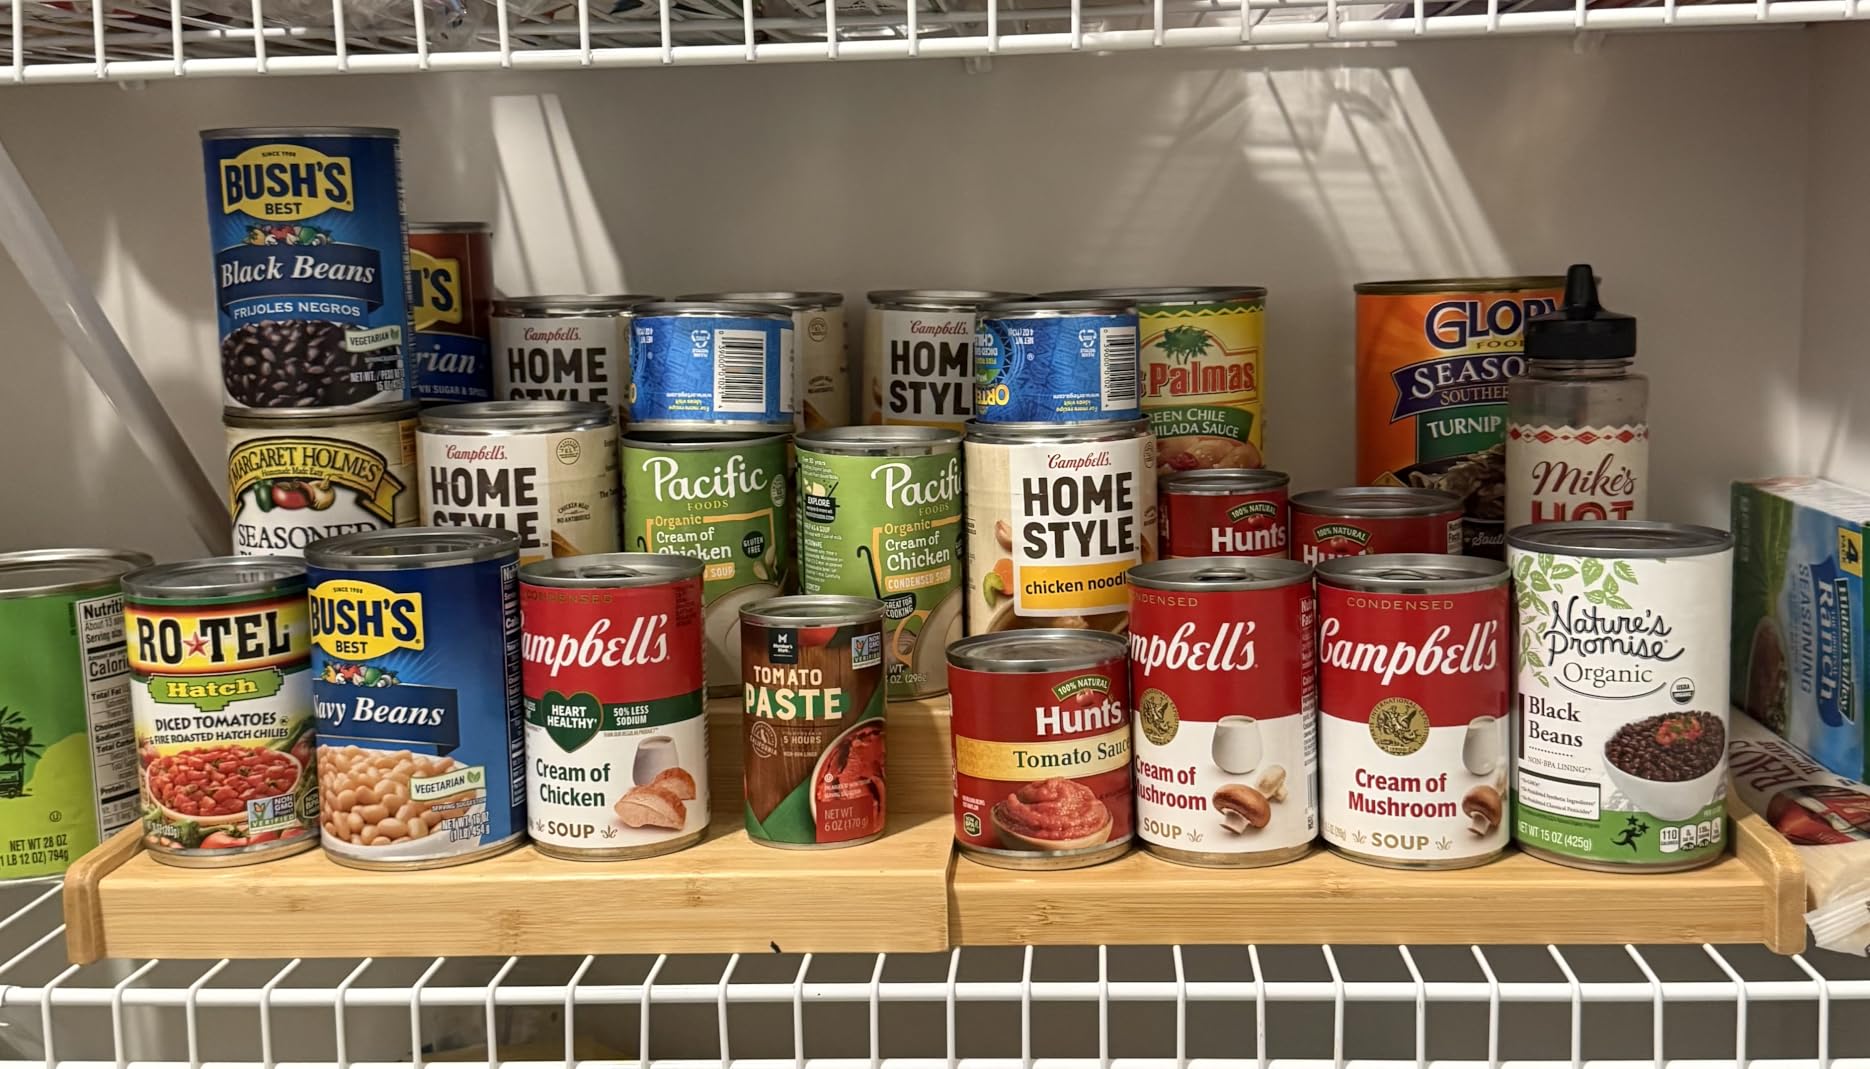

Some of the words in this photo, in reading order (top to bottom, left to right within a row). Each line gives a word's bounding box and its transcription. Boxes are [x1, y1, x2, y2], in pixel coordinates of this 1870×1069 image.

[224, 162, 350, 206] BUSH'S
[265, 203, 302, 215] BEST
[222, 257, 284, 288] Black
[292, 256, 375, 283] Beans
[234, 302, 293, 320] FRIJOLES
[298, 302, 360, 316] NEGROS
[350, 331, 389, 345] VEGETARIAN
[523, 327, 580, 345] Campbell's
[910, 321, 968, 336] Campbell's
[508, 353, 608, 384] HOME
[891, 340, 976, 378] HOM
[1148, 360, 1256, 397] Palmas
[432, 387, 460, 396] SUGAR
[890, 380, 976, 416] STYL
[1187, 408, 1226, 422] CHILE
[1202, 422, 1239, 438] SAUCE
[1426, 416, 1502, 439] TURNIP
[231, 446, 297, 482] MARGARET
[302, 446, 380, 482] HOLMES
[446, 444, 508, 465] Campbell's
[1048, 451, 1112, 472] Campbell's
[642, 455, 768, 501] Pacific
[871, 457, 962, 509] Pacifi
[1532, 453, 1640, 497] Mike's
[430, 467, 538, 508] HOME
[1022, 472, 1133, 517] HOME
[687, 500, 729, 511] FOODS
[920, 503, 950, 517] FOODS
[1231, 506, 1248, 519] 100%
[1249, 503, 1276, 515] NATURAL
[655, 515, 702, 530] Organic
[885, 519, 930, 538] Organic
[657, 531, 697, 544] Cream
[700, 527, 715, 541] of
[743, 537, 763, 547] GLUTEN
[885, 536, 927, 552] Cream
[928, 531, 940, 547] of
[1023, 516, 1136, 559] STYLE
[1316, 528, 1332, 538] 100%
[1332, 526, 1366, 541] NATURAL
[1840, 535, 1848, 563] PACK
[1846, 538, 1860, 565] 4
[887, 548, 950, 571] Chicken
[711, 567, 735, 578] SOUP
[888, 573, 934, 590] CONDENSED
[1025, 580, 1083, 595] chicken
[1088, 571, 1128, 592] noodl
[886, 600, 903, 609] GREAT
[1135, 593, 1198, 607] DENSED
[1346, 597, 1455, 610] CONDENSED
[311, 599, 418, 643] BUSH'S
[886, 605, 913, 618] COOKING
[1550, 596, 1672, 636] Nature's
[1837, 586, 1851, 653] Hidden
[1799, 564, 1812, 694] SEASONING
[335, 640, 368, 655] BEST
[1129, 621, 1256, 677] mpbell's
[1543, 630, 1685, 666] Promise
[1817, 580, 1838, 699] Ranch
[1320, 617, 1497, 685] Campbell's
[753, 665, 823, 686] TOMATO
[889, 664, 905, 673] WT.
[1563, 662, 1653, 687] Organic
[167, 679, 258, 699] Hatch
[1057, 682, 1076, 696] 100%
[1077, 678, 1109, 690] NATURAL
[1839, 657, 1853, 710] Valley
[91, 690, 109, 700] Total
[745, 682, 842, 721] PASTE
[352, 696, 444, 727] Beans
[550, 705, 587, 718] HEART
[613, 707, 630, 717] 50%
[631, 705, 649, 715] LESS
[1528, 696, 1582, 723] Black
[155, 716, 196, 732] DICED
[199, 712, 277, 729] TOMATOES
[616, 715, 648, 726] SODIUM
[155, 735, 170, 745] FIRE
[170, 732, 214, 744] ROASTED
[216, 730, 251, 743] HATCH
[252, 727, 289, 740] CHILIES
[782, 735, 790, 745] 5
[791, 735, 823, 745] HOURS
[1528, 722, 1583, 748] Beans
[96, 744, 115, 754] Total
[1013, 749, 1092, 769] Tomato
[1097, 736, 1131, 761] Sauce
[536, 758, 587, 782] Cream
[590, 762, 610, 782] of
[1136, 755, 1174, 783] Cream
[1177, 765, 1196, 785] of
[1527, 756, 1556, 769] NON-BPA
[414, 775, 465, 794] VEGETARIAN
[1355, 768, 1421, 793] Cream
[1425, 772, 1447, 793] of
[274, 795, 293, 805] NON
[540, 783, 606, 807] Chicken
[1136, 778, 1207, 811] ushroom
[1348, 790, 1457, 817] Mushroom
[274, 802, 294, 811] GMO
[825, 809, 840, 821] NET
[841, 806, 853, 819] WT
[251, 813, 295, 828] VERIFIED
[548, 821, 595, 839] SOUP
[825, 821, 831, 832] 6
[832, 820, 845, 832] OZ
[1143, 817, 1182, 840] SOUP
[9, 839, 25, 852] NET
[28, 838, 41, 850] WT
[56, 834, 68, 847] OZ
[1371, 832, 1430, 850] SOUP
[1529, 824, 1540, 838] WT
[1541, 828, 1550, 841] 15
[1551, 830, 1564, 845] OZ
[1564, 834, 1593, 851] (425g)
[1662, 829, 1678, 841] 110
[7, 854, 18, 866] LB
[19, 853, 30, 864] 12
[32, 851, 47, 865] OZ)
[48, 849, 69, 862] 794g
